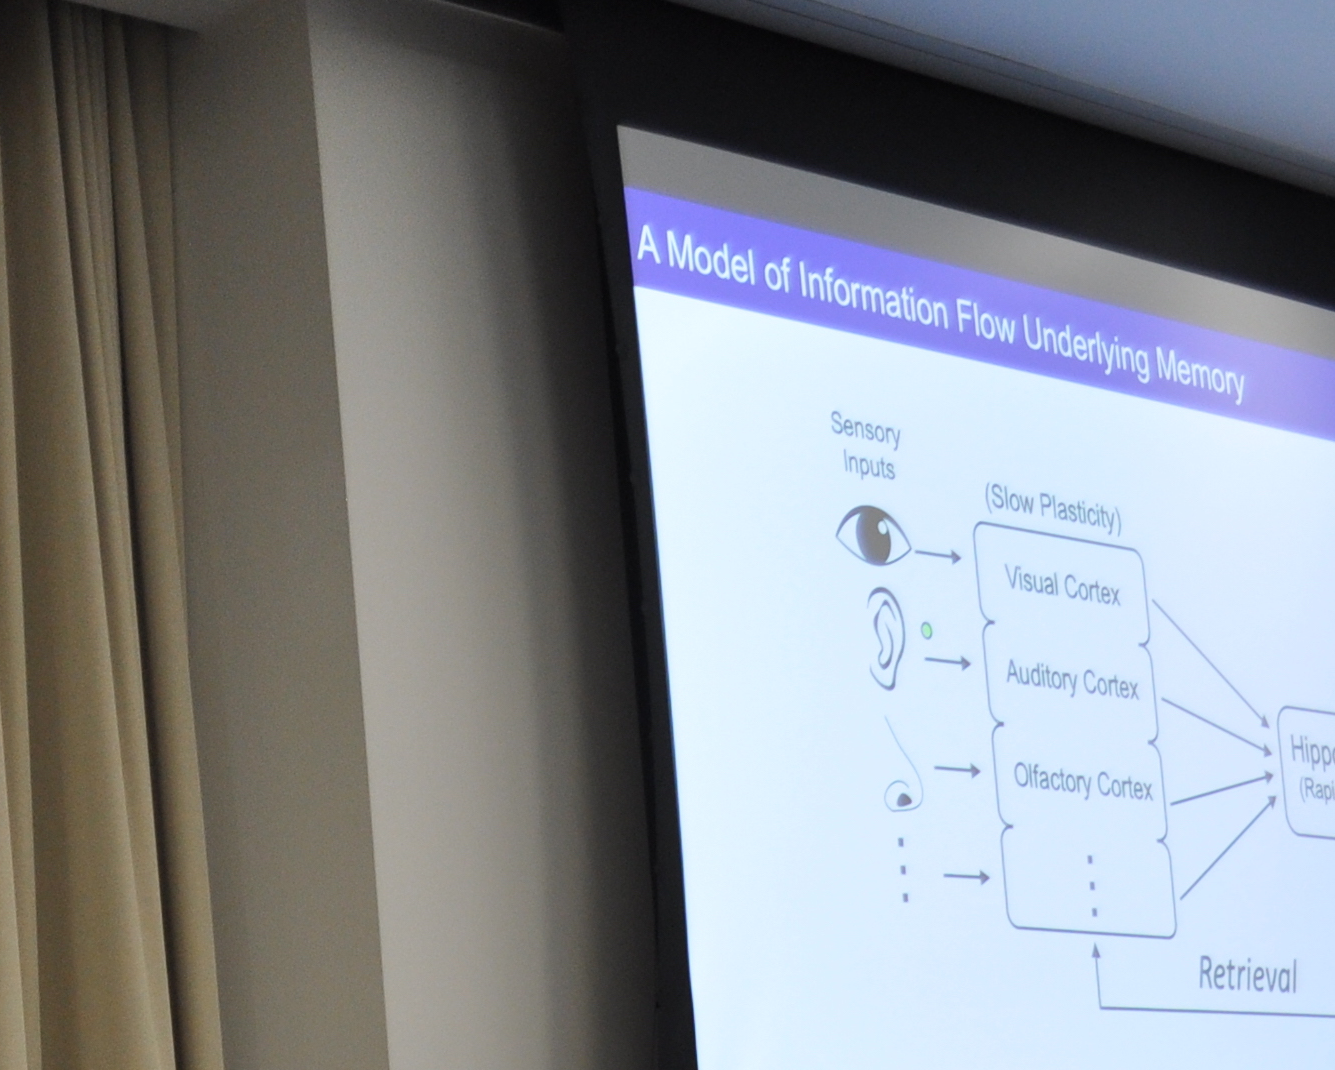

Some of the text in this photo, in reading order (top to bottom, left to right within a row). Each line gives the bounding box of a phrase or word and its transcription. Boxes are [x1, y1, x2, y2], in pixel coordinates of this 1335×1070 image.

[636, 223, 1245, 406] A Model of Information Flow Underlying Memory
[830, 410, 901, 451] Sensory
[843, 448, 896, 481] Inputs
[984, 481, 1123, 537] (Slow Plasticity)
[1004, 563, 1122, 607] Visual Cortex
[1006, 658, 1141, 701] Auditory Cortex
[1013, 761, 1154, 802] Olfactory Cortex
[1198, 954, 1299, 995] Retrieval
